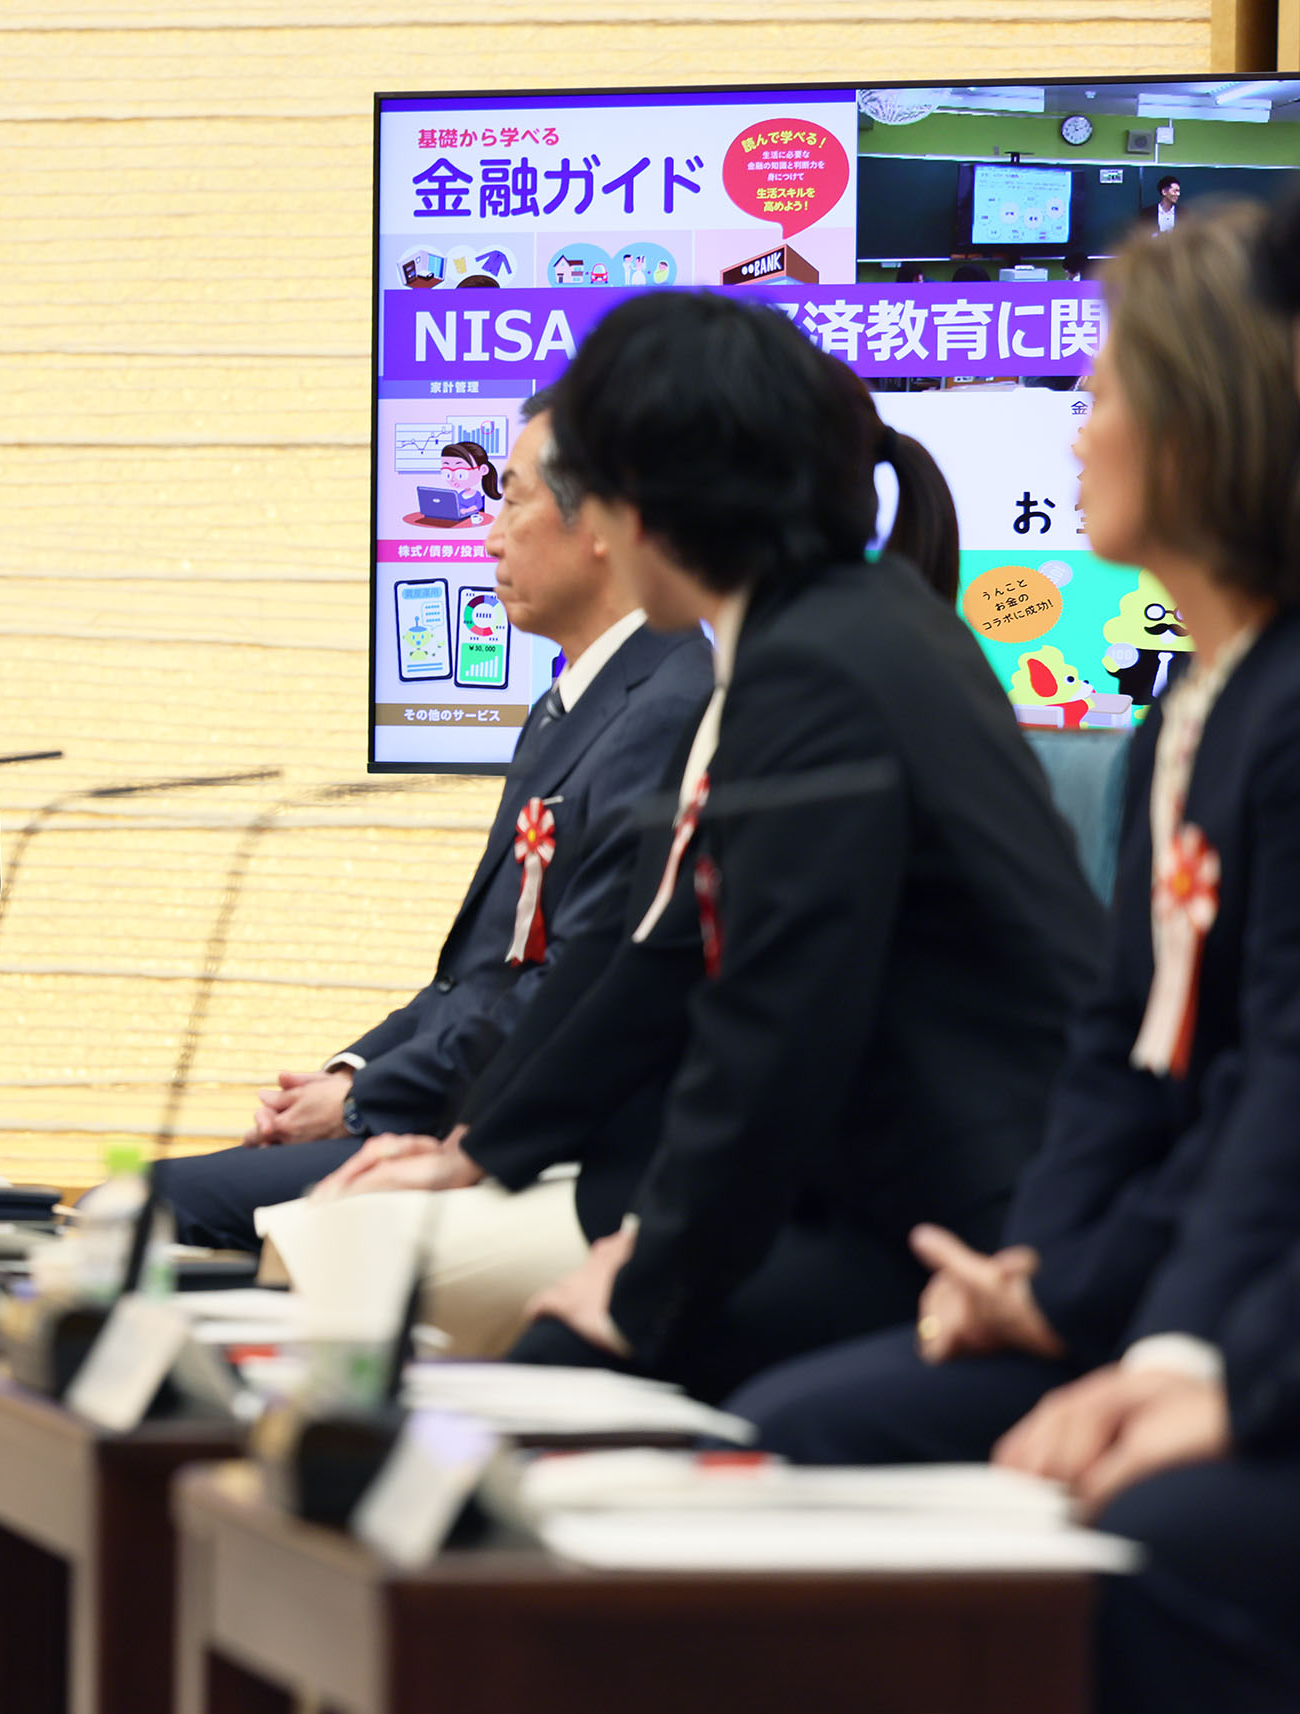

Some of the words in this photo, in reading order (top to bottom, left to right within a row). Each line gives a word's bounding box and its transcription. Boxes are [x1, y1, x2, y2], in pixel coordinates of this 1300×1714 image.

[418, 127, 560, 149] 基礎から学べる
[412, 154, 704, 219] 金融ガイド
[756, 187, 816, 199] 生活スキルを
[774, 299, 1108, 361] 済教育に関
[430, 381, 479, 394] 家計管理
[398, 545, 495, 558] 株式/債券/投資
[982, 579, 1028, 600] うんこと
[995, 593, 1029, 611] お金の
[404, 709, 500, 722] その他のサービス
